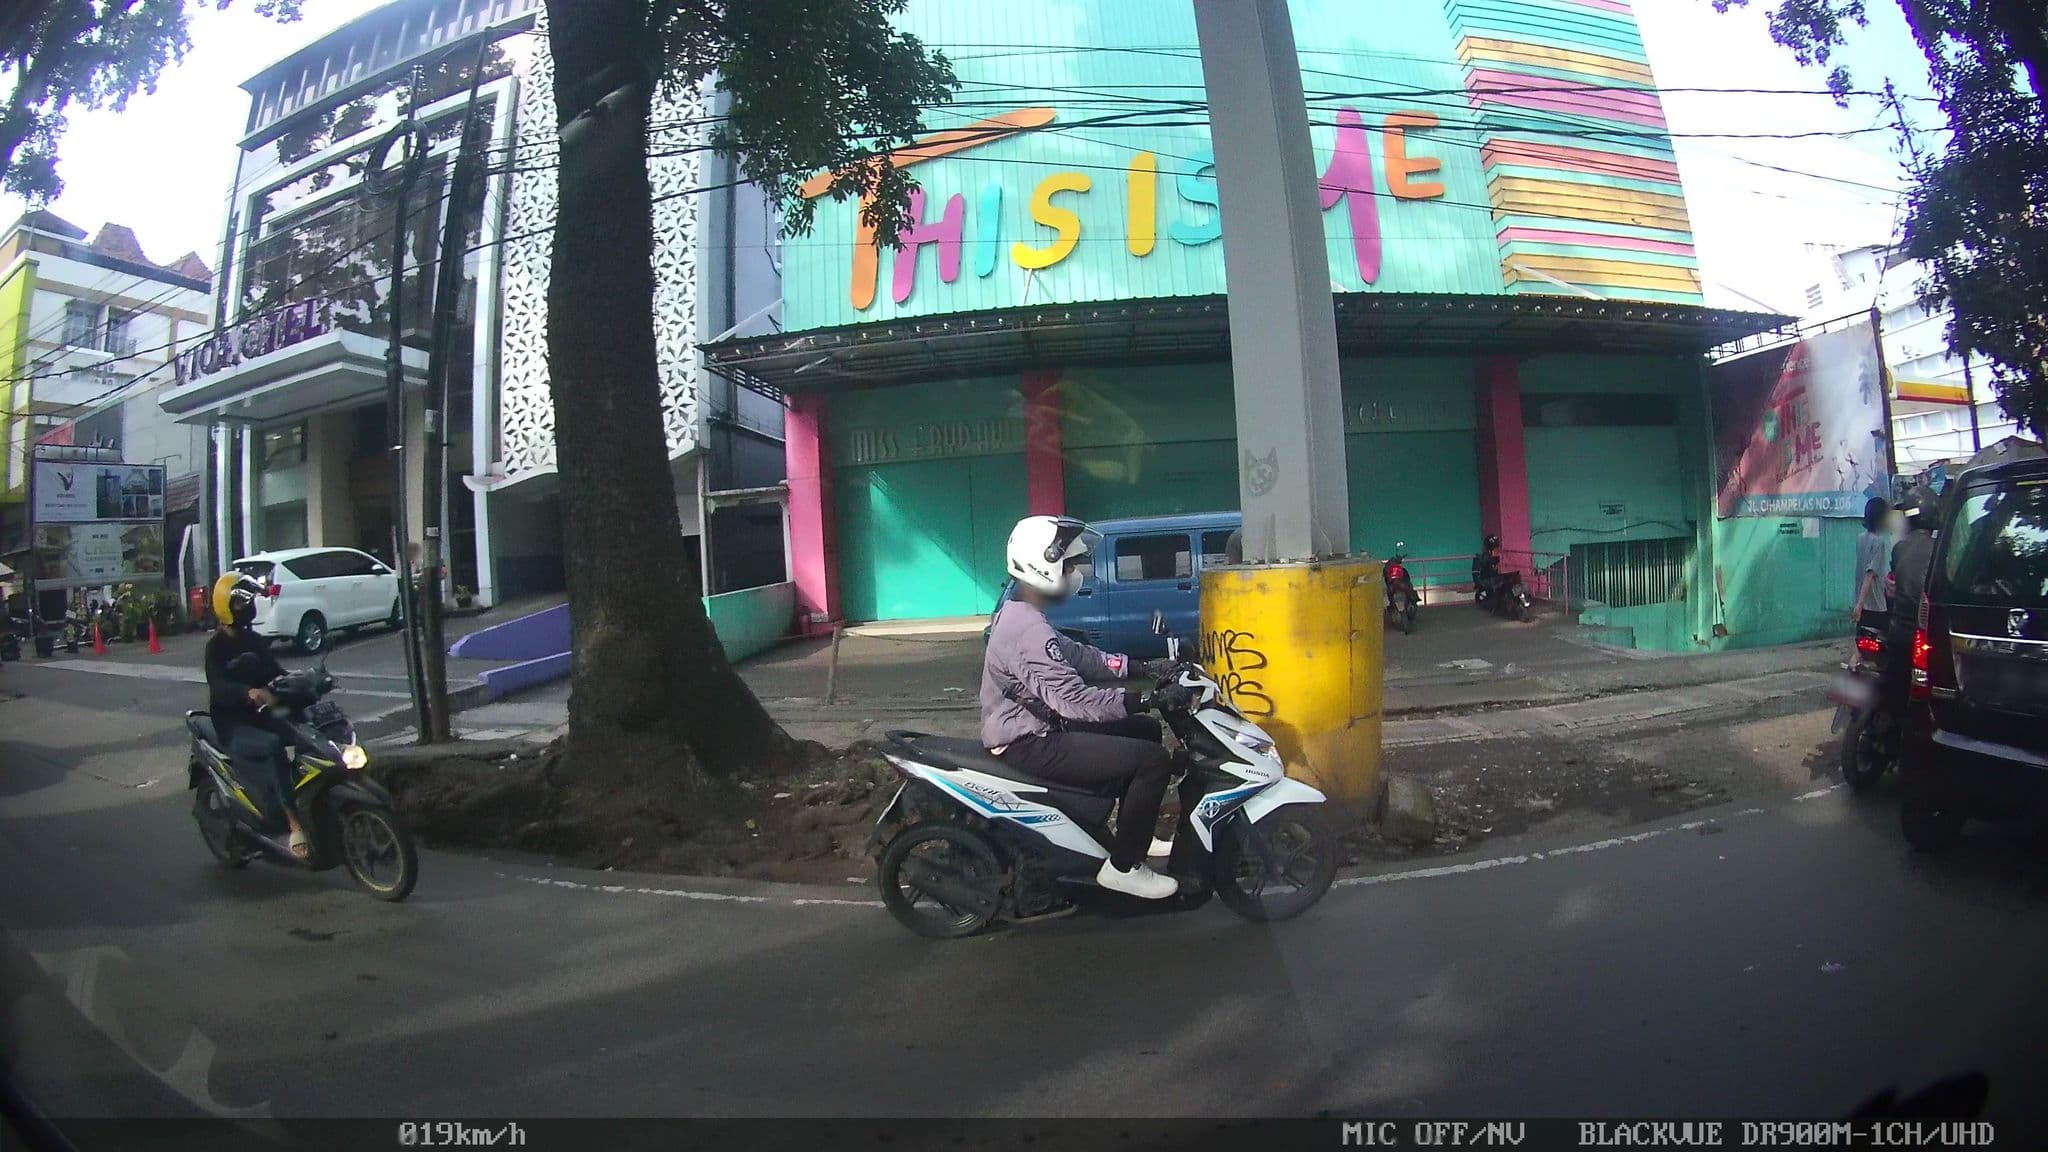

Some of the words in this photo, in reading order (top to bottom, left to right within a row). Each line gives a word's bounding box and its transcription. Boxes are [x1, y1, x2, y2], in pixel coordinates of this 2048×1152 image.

[795, 107, 1092, 310] THIS
[1760, 497, 1815, 513] CIHAMPELAS
[1815, 497, 1833, 511] NO.
